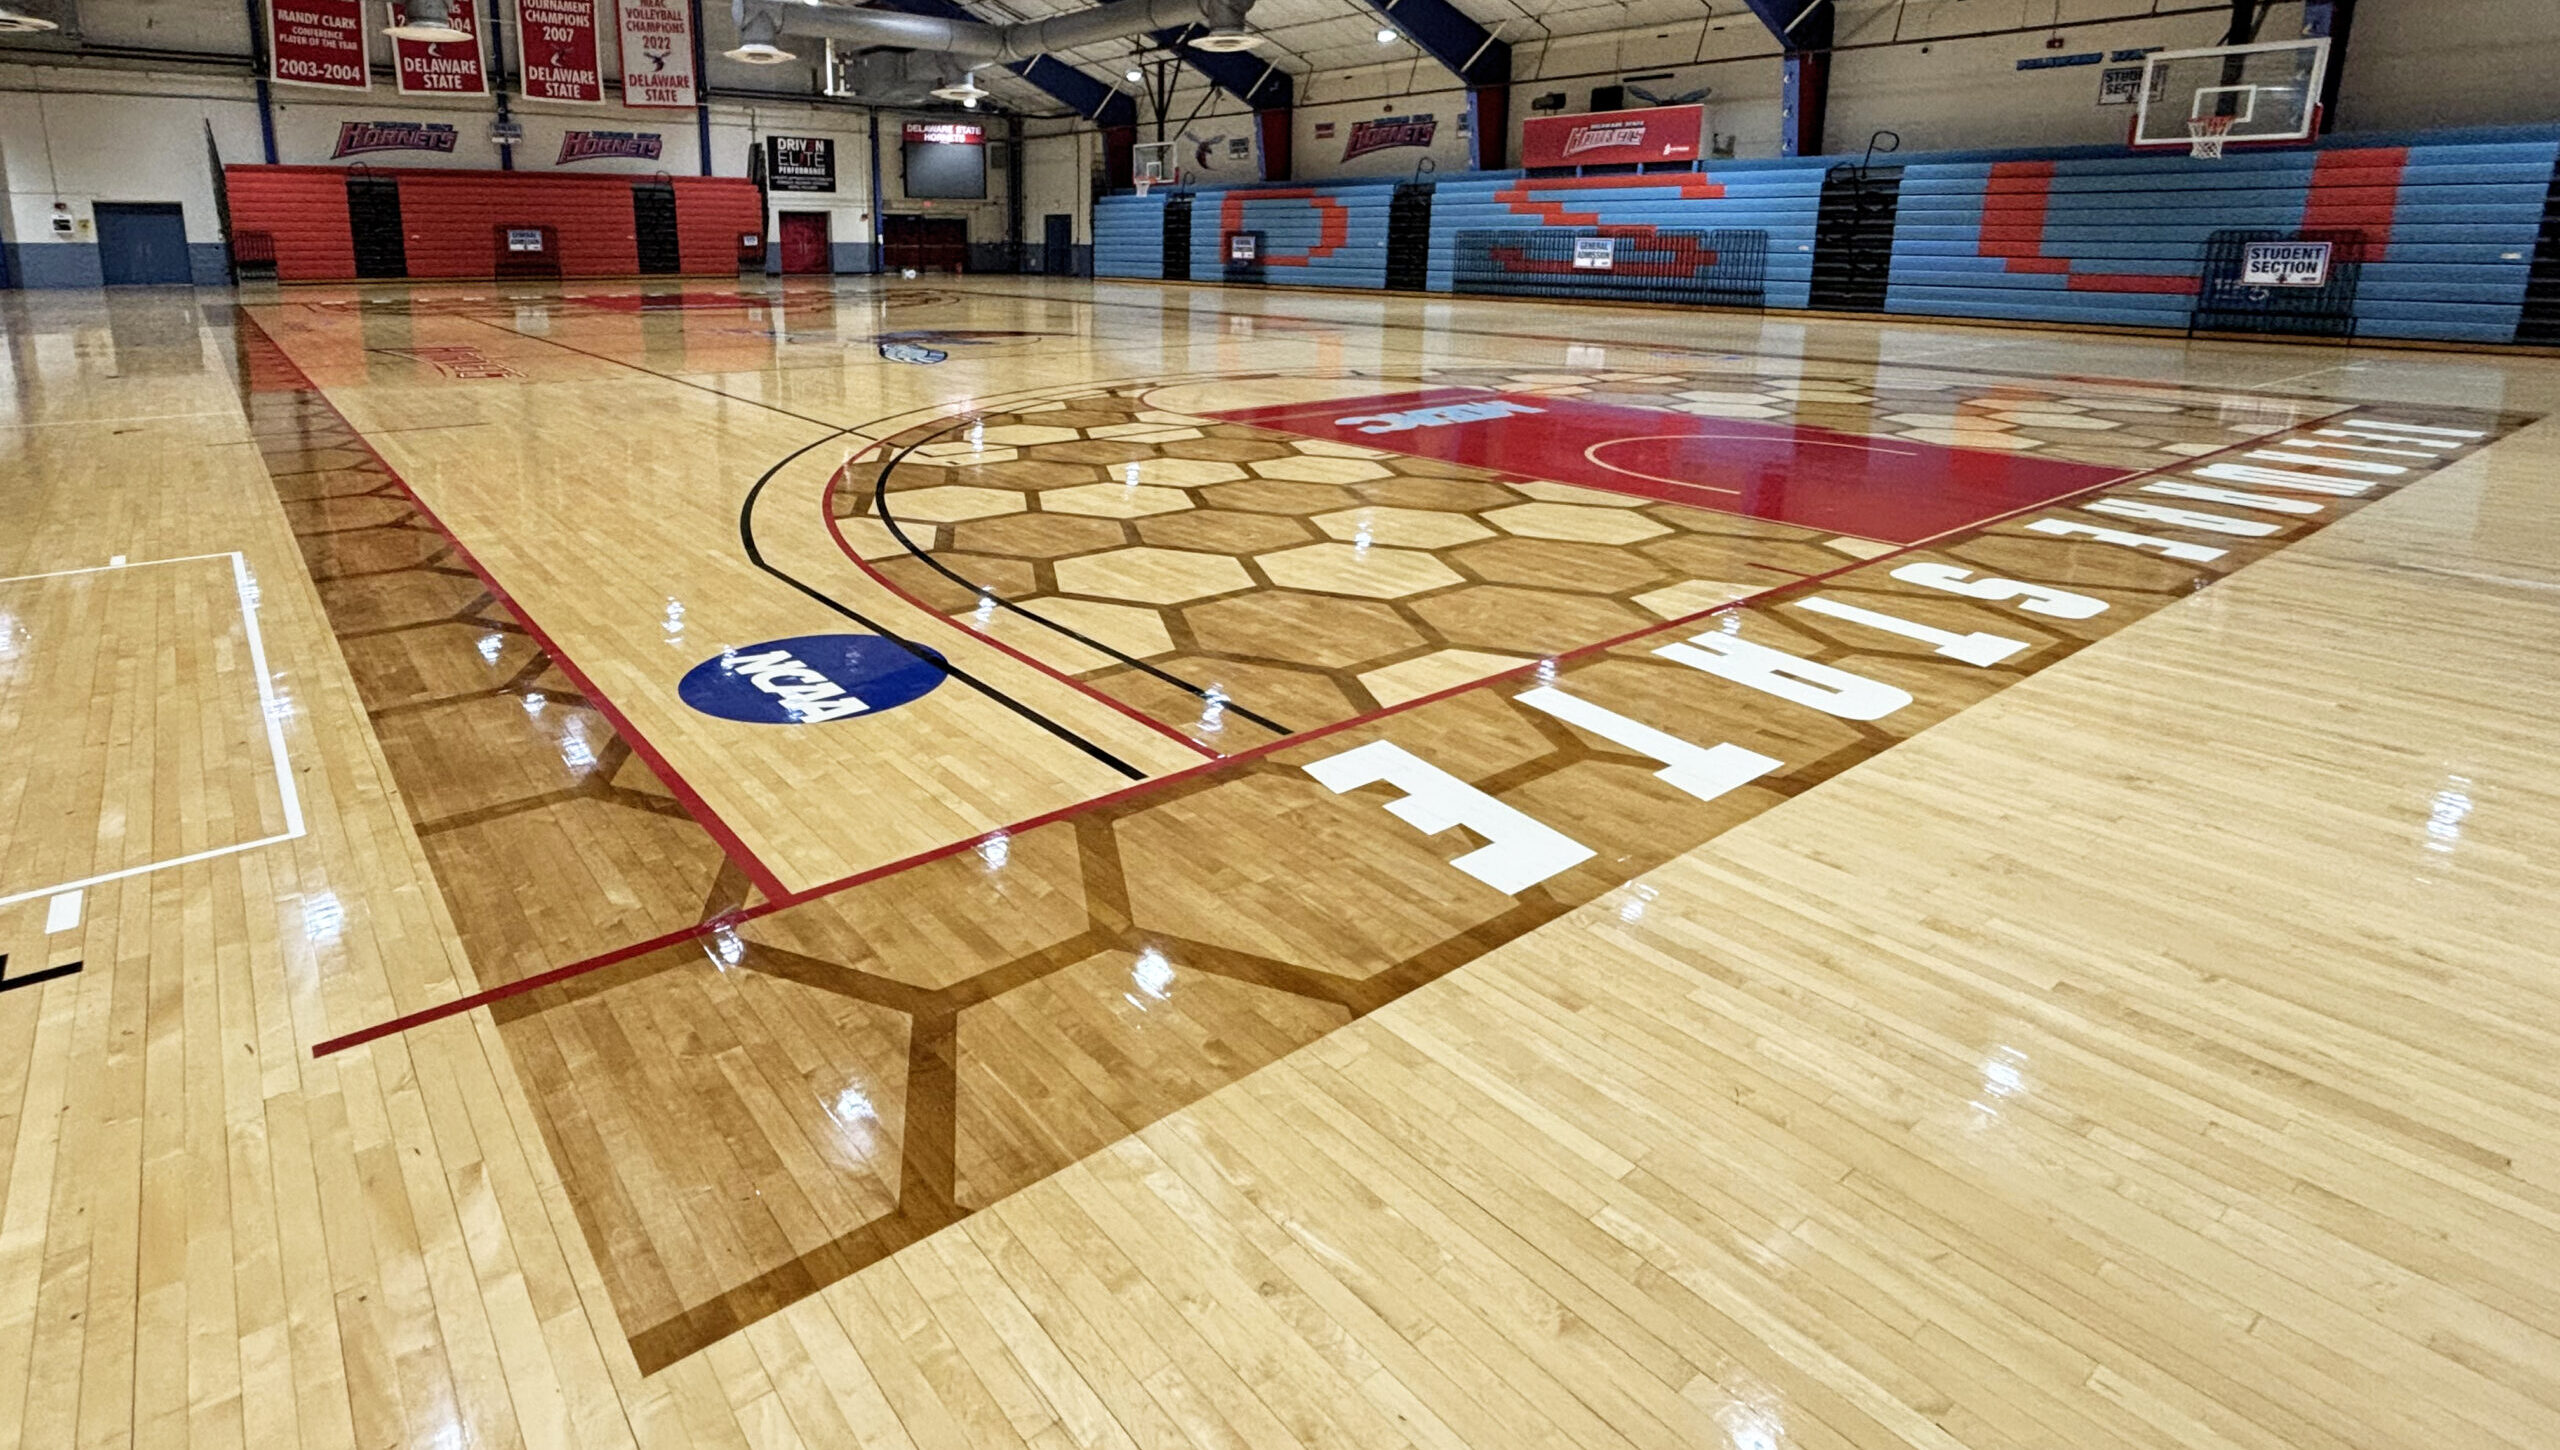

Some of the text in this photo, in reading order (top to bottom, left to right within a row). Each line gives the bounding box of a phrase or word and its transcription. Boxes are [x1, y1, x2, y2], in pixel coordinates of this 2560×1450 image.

[523, 0, 591, 13] TOURNAMENT
[625, 7, 684, 21] VOLLEYBALL
[278, 9, 357, 29] MANDY CLARK
[525, 10, 590, 27] CHAMPIONS
[292, 26, 344, 40] CONFERENCE
[542, 26, 574, 42] 2007
[626, 21, 685, 33] CHAMPIONS
[280, 33, 358, 50] PLAYER OF THE YEAR
[642, 35, 671, 49] 2022
[279, 58, 361, 80] 2003-2004
[403, 57, 478, 75] DELAWARE
[423, 74, 463, 89] STATE
[528, 66, 596, 84] DELAWARE
[628, 74, 690, 88] DELAWARE
[545, 83, 581, 98] STATE
[645, 89, 678, 102] STATE
[906, 124, 982, 135] DELAWARE STATE
[330, 121, 459, 160] HORNETS
[1341, 121, 1439, 164] HORNETS
[556, 131, 662, 166] HORNETS
[777, 150, 826, 168] ELITE
[1580, 241, 1608, 250] GENERAL
[1577, 250, 1610, 259] ADMISSION
[2250, 247, 2323, 260] STUDENT
[2250, 261, 2318, 273] SECTION
[1300, 419, 2487, 896] DELAWARE STATE
[728, 650, 871, 723] NCAA
